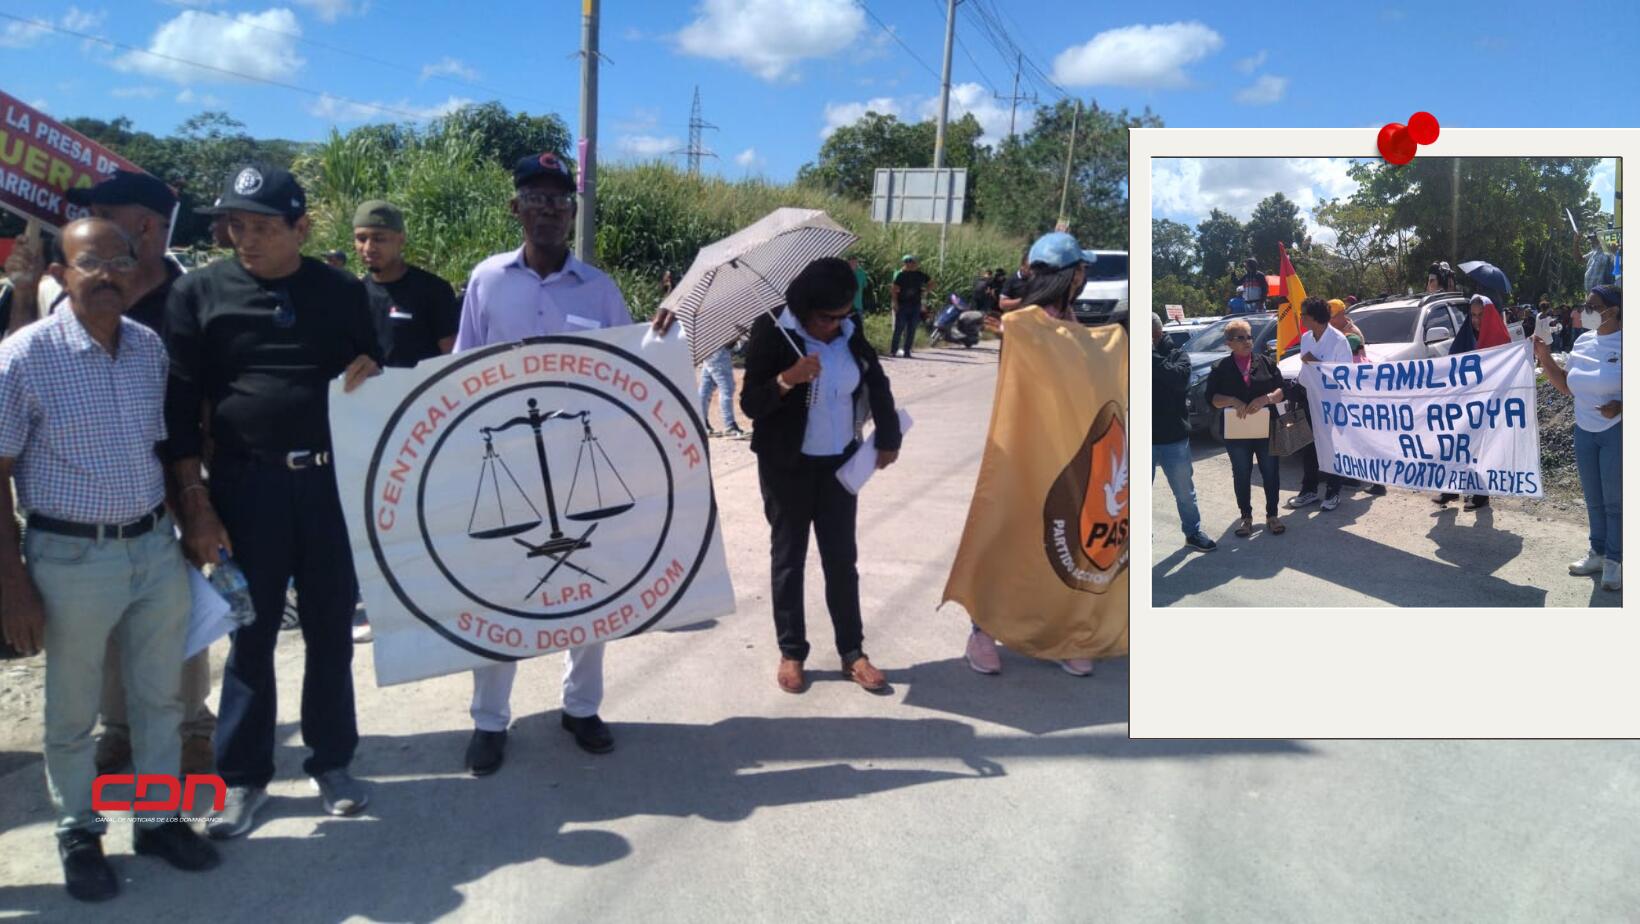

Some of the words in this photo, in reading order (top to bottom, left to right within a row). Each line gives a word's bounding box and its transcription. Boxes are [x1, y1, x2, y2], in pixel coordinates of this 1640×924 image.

[6, 105, 30, 134] LA
[35, 122, 92, 166] PRESA
[96, 154, 119, 178] DE
[1316, 365, 1351, 390] LA
[1355, 354, 1483, 391] FAMILIA
[1320, 400, 1414, 431] ROSARIO
[1427, 397, 1527, 431] APOYA
[378, 395, 460, 531] CENTRAL
[462, 364, 515, 397] DEL
[523, 353, 648, 402] DERECHO
[652, 400, 701, 469] L.P.R
[1398, 434, 1434, 460] AL
[1437, 434, 1478, 464] DR.
[1333, 453, 1391, 483] JOHNNY
[1393, 460, 1446, 488] PORTO
[1448, 470, 1484, 491] REAL
[1486, 469, 1538, 494] REYES
[1053, 519, 1074, 572] PARTIDO
[457, 611, 528, 649] STGO.
[537, 626, 587, 650] DGO
[592, 604, 639, 639] REP.
[640, 559, 685, 610] DOM
[542, 583, 593, 607] L.P.R
